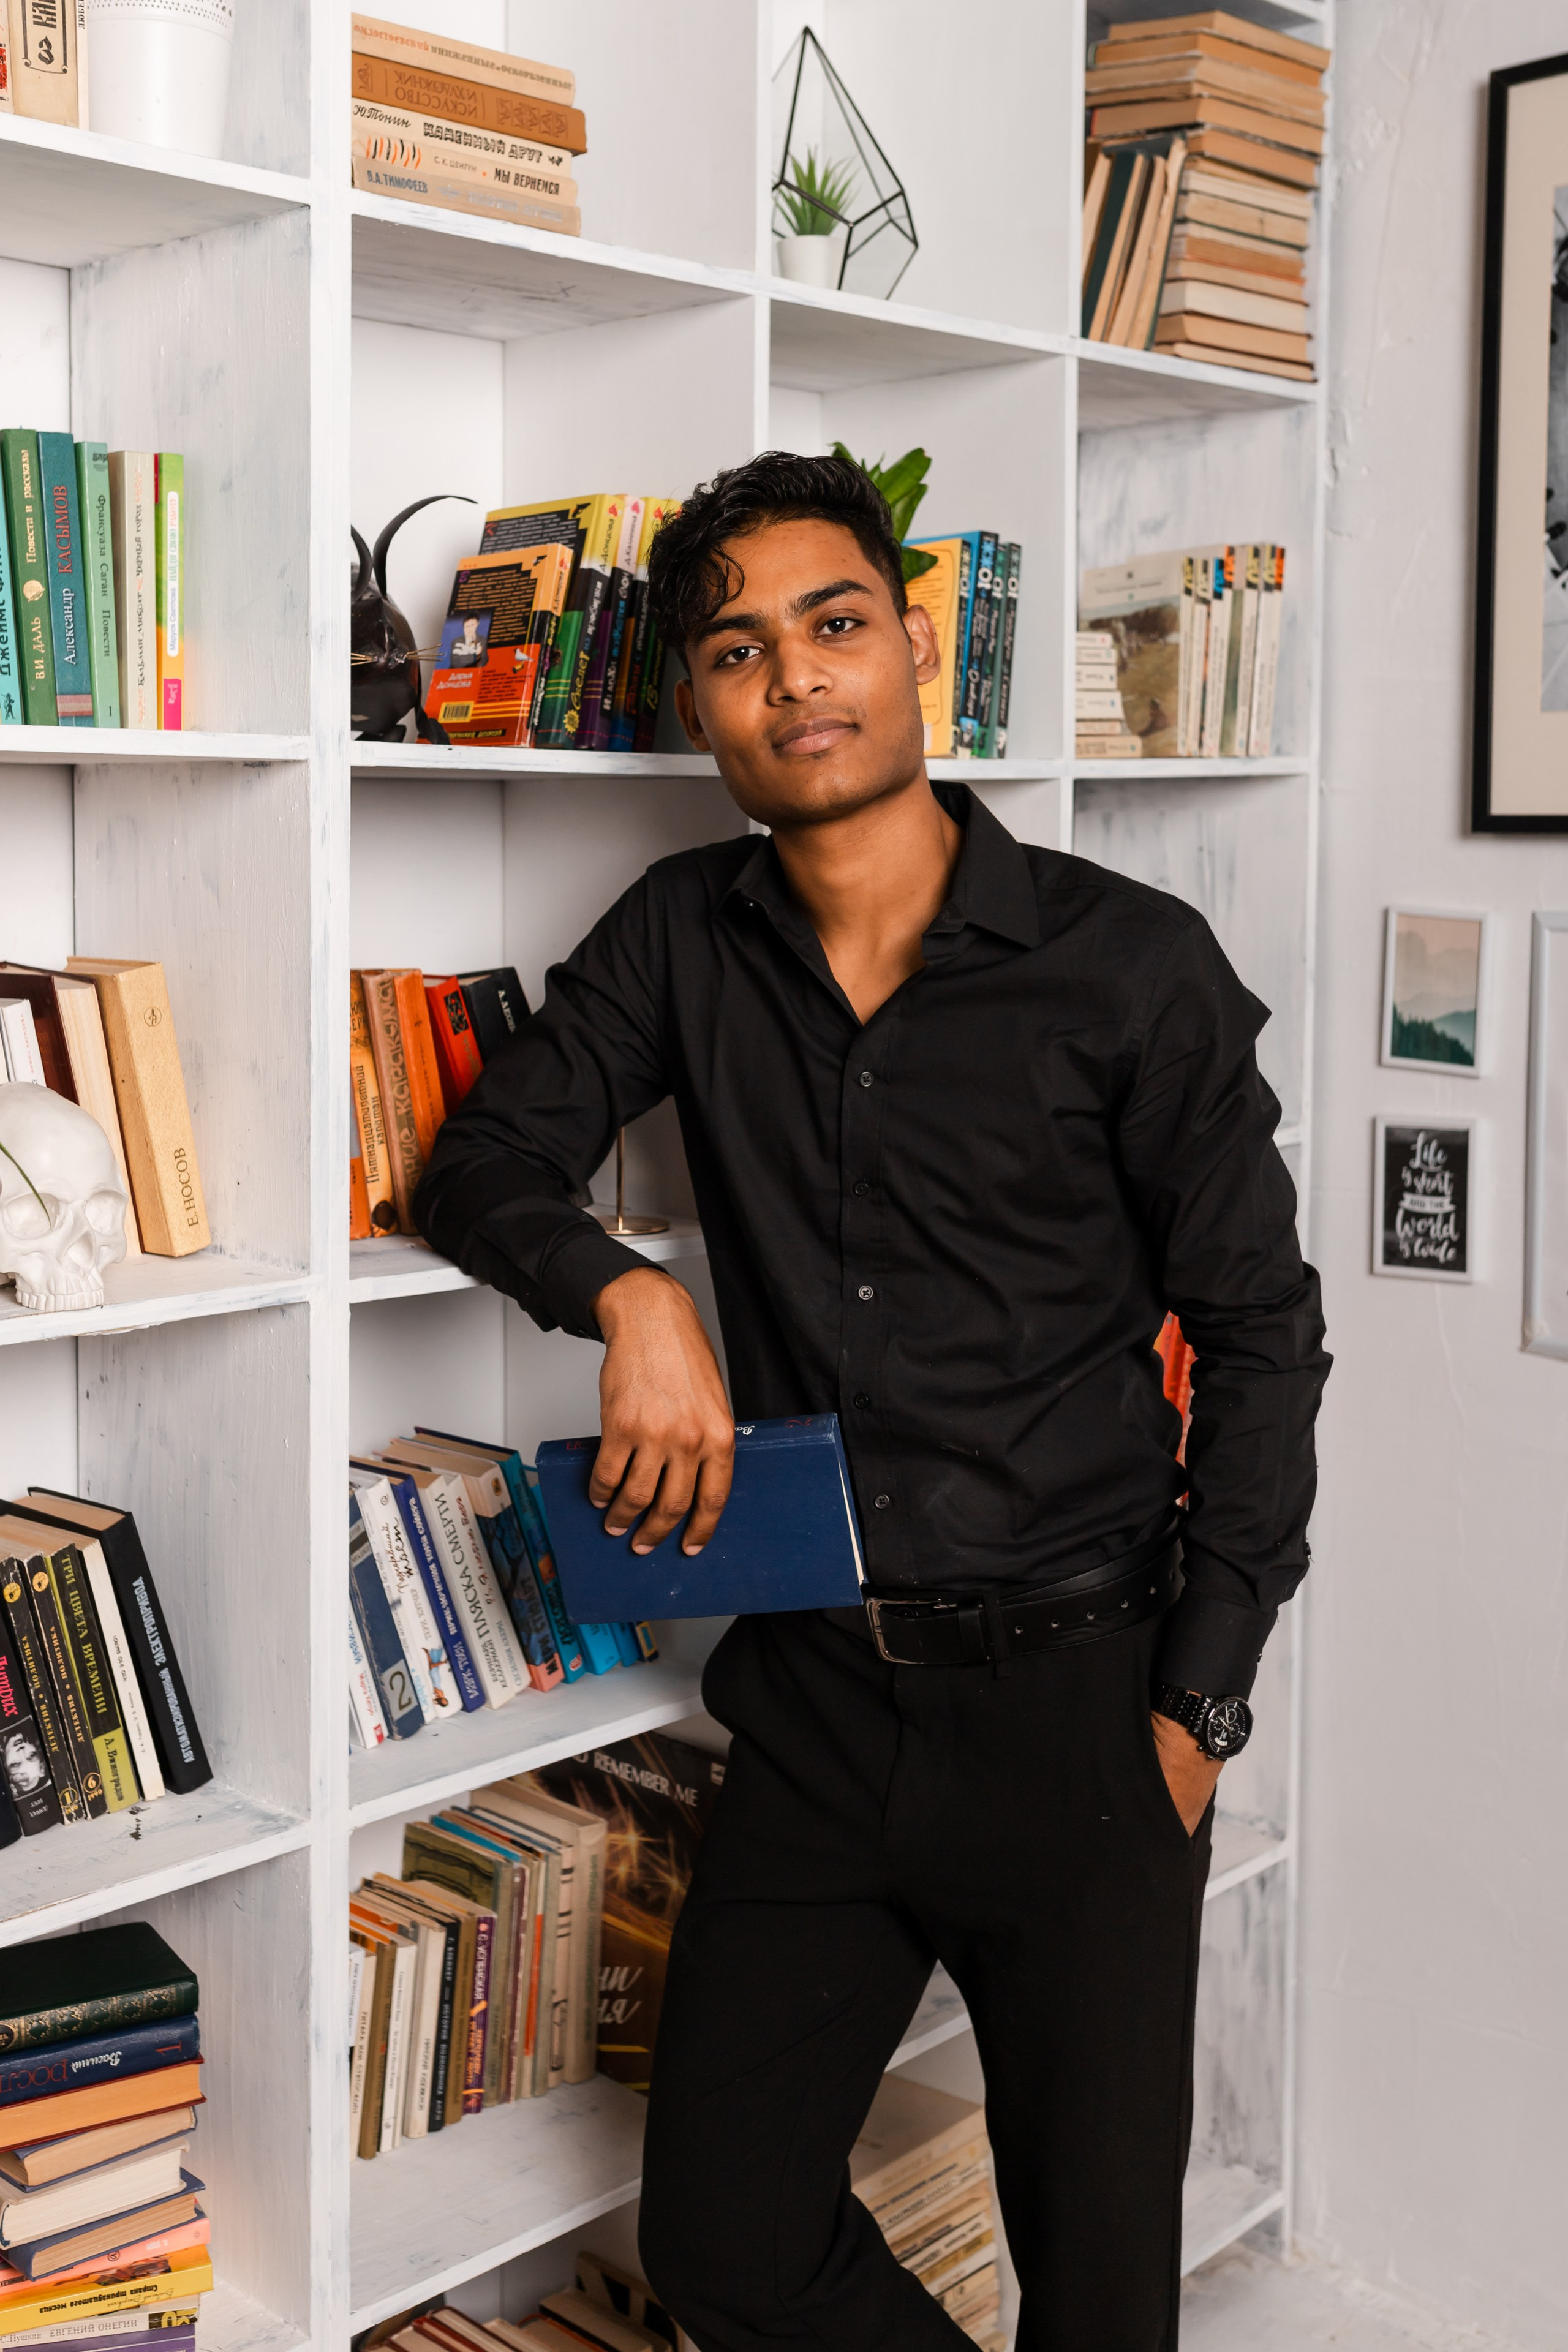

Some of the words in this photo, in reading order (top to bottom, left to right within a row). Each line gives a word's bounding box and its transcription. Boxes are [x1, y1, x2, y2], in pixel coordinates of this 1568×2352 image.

[494, 167, 510, 183] МЫ
[513, 170, 560, 196] ВЕРНЕМСЯ
[20, 449, 35, 499] рассказы
[25, 517, 37, 563] Повести
[53, 485, 73, 574] КАСЫМОВ
[96, 494, 107, 557] Франсуаза
[99, 563, 110, 597] Саган
[30, 617, 45, 653] ДАЛЬ
[62, 587, 76, 665] Александр
[101, 609, 111, 657] Повести
[352, 1065, 380, 1183] Пятнадцатилетний
[371, 1096, 386, 1146] капитан
[1409, 1131, 1449, 1172] Life
[1401, 1166, 1412, 1188] is
[1414, 1170, 1455, 1196] short
[391, 1517, 415, 1578] тост
[434, 1492, 466, 1566] СМЕРТИ
[61, 1553, 78, 1585] ТРИ
[68, 1589, 88, 1639] ЦВЕТА
[132, 1575, 167, 1667] ЭЛЕКТРОПРИВОД
[457, 1566, 491, 1639] ПЛЯСКА
[22, 1635, 40, 1689] ПОЛИТИКА
[50, 1626, 67, 1680] ПОЛИТИКА
[452, 1641, 470, 1670] ТВЕН
[82, 1643, 108, 1714] ВРЕМЕНИ
[388, 1670, 413, 1712] 2
[462, 1672, 480, 1700] МАРК
[40, 1703, 59, 1752] ДЕТЕКТИВ
[67, 1694, 85, 1743] ДЕТЕКТИВ
[157, 1667, 195, 1763] АВТОМАТИЗИРОВАННЫЙ
[88, 1775, 97, 1789] 6
[594, 1751, 670, 1797] REMEMBER
[674, 1783, 699, 1807] ME
[71, 2050, 123, 2073] Василий
[39, 2302, 67, 2314] месяца
[69, 2291, 127, 2307] тринадцатого
[130, 2284, 158, 2295] Страна
[50, 2325, 96, 2337] ЕВГЕНИЙ
[98, 2319, 138, 2331] ОНЕГИН
